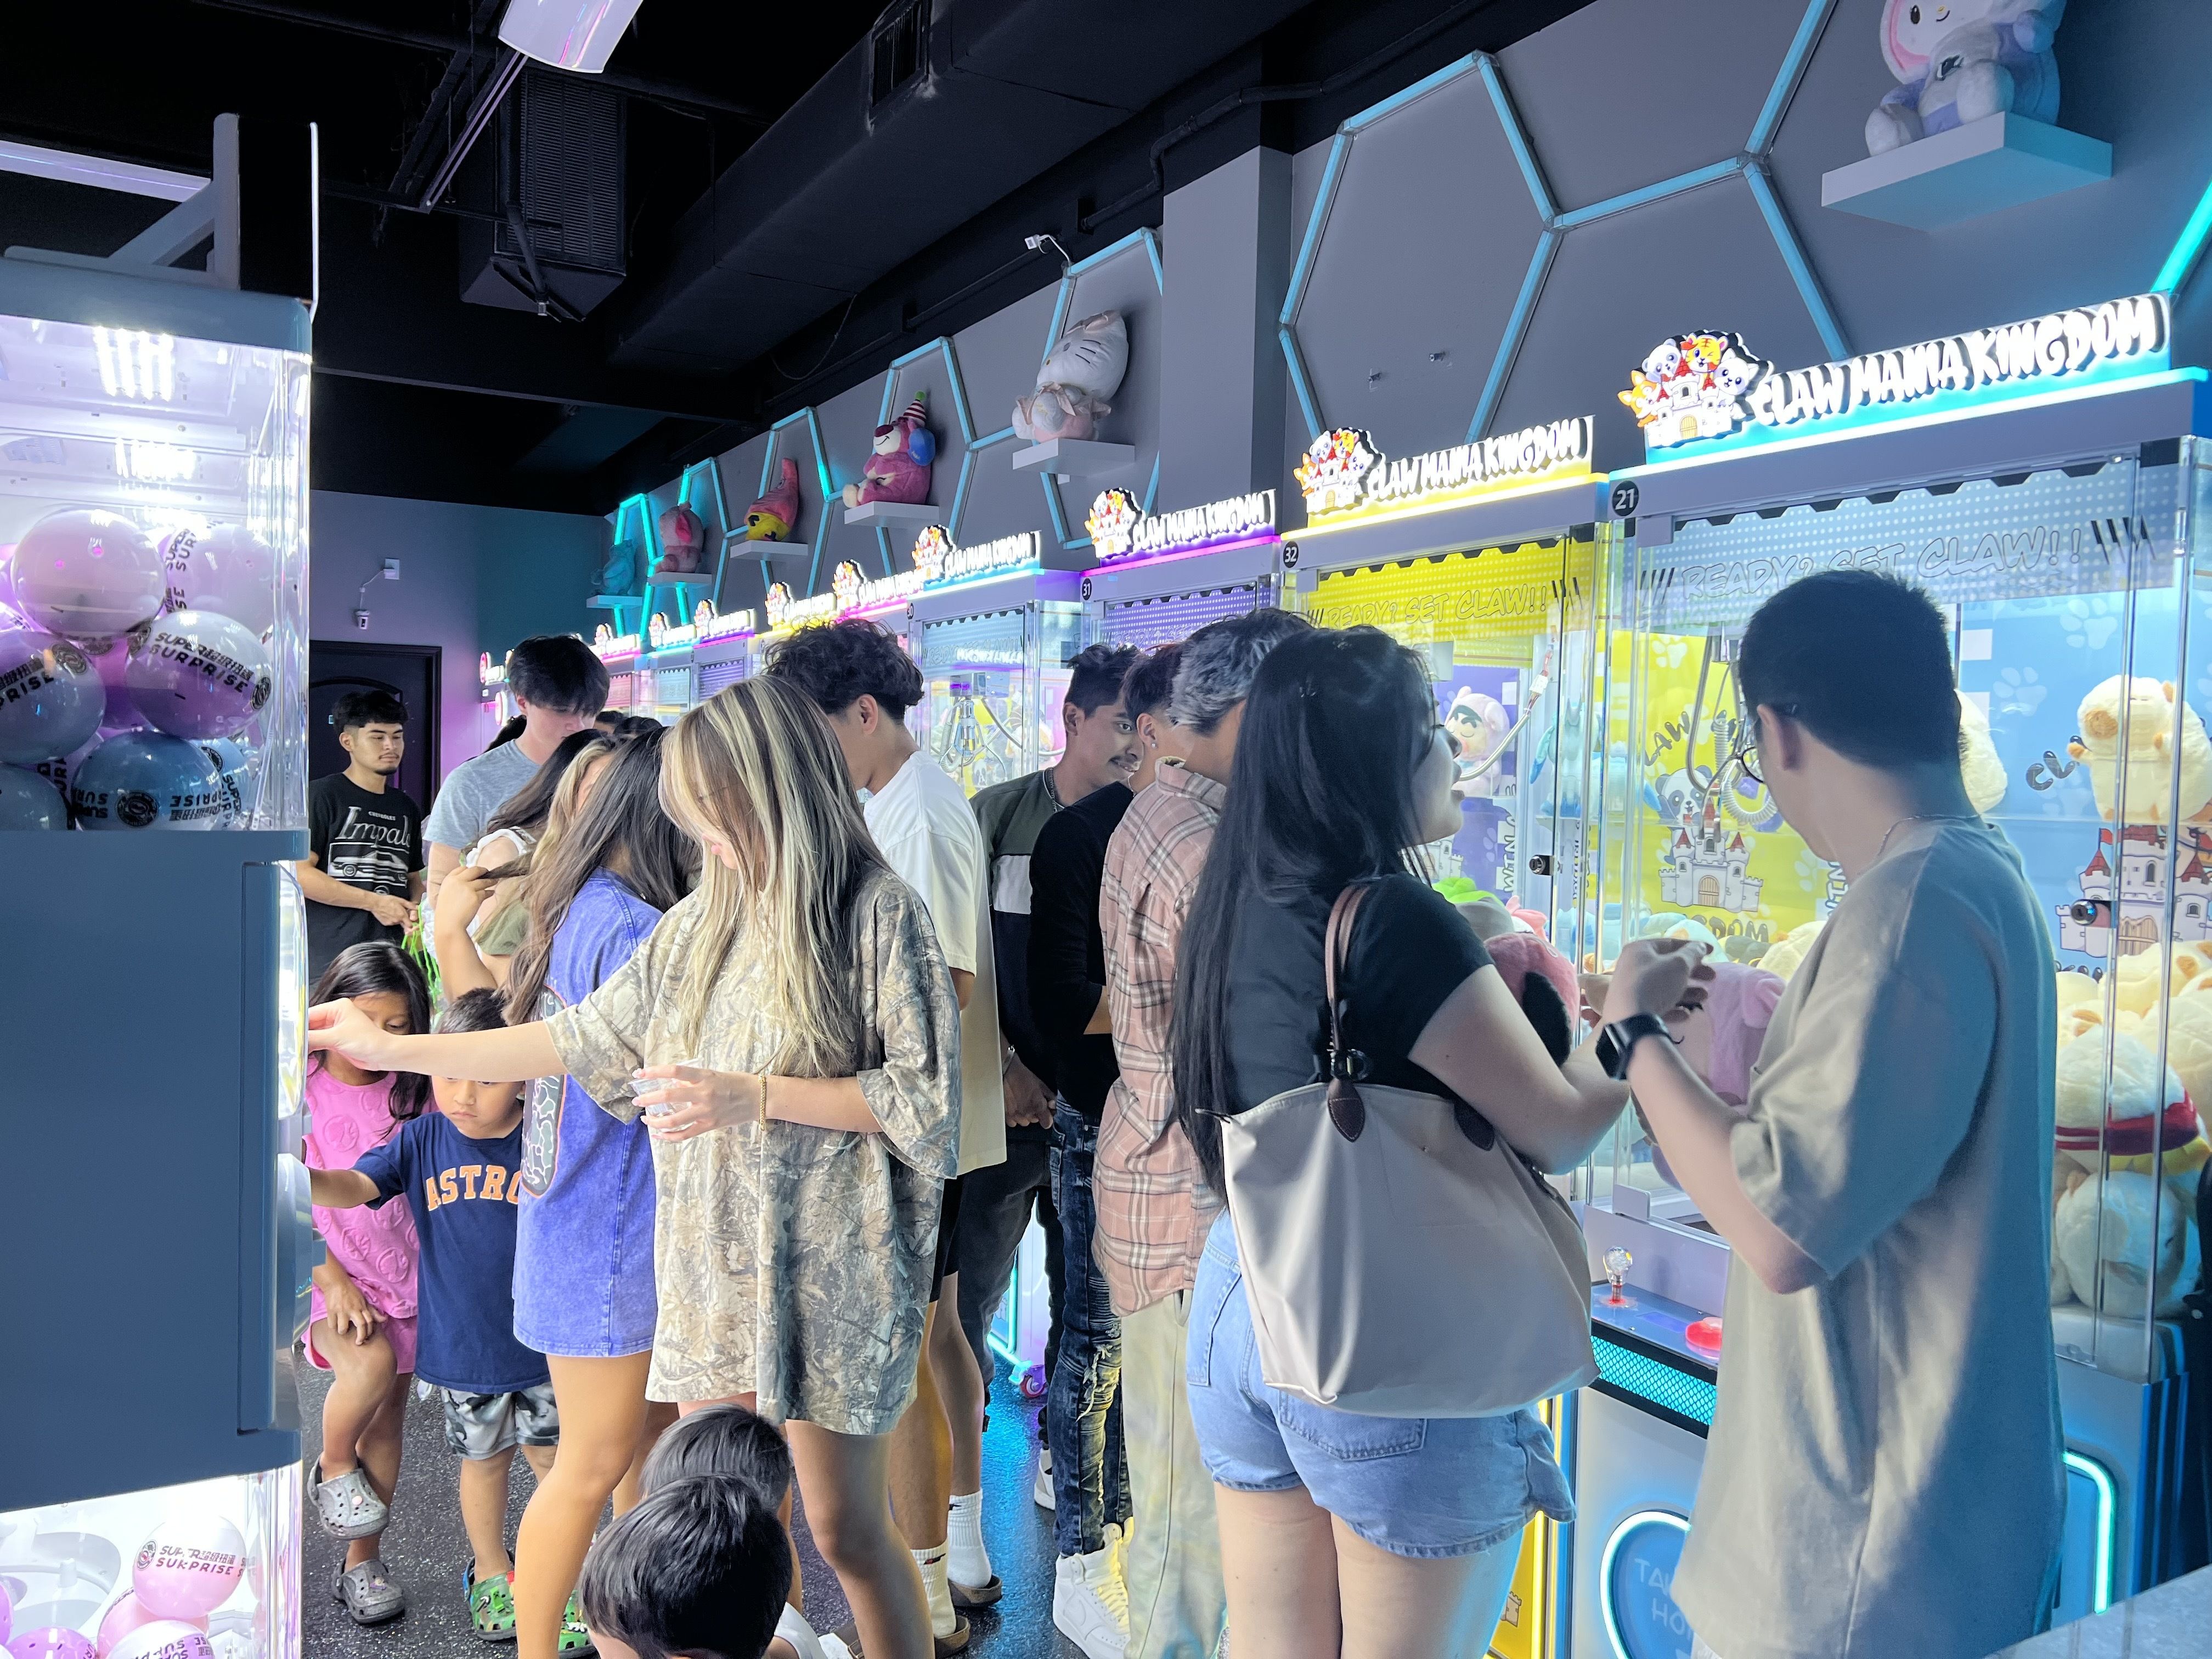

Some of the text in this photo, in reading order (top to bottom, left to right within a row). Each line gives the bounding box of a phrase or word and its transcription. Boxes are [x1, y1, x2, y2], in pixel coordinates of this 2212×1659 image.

[1757, 295, 2164, 426] CLAW MANIA KINGDOM
[1367, 418, 1585, 501] CLAW MANIA KINGDOM
[1133, 516, 1166, 549] CLAW
[1207, 492, 1266, 534] KINGDOM
[1615, 489, 1635, 510] 21
[1284, 548, 1298, 563] 32
[1682, 556, 1814, 599] READY?
[1917, 526, 2081, 578] CLAW!!
[1082, 583, 1091, 596] 31
[1328, 584, 1547, 629] READY? SET CLAW!!
[149, 644, 249, 693] SURPRISE
[1645, 711, 1690, 766] LAW
[156, 1557, 234, 1576] SURPRISE
[1651, 1598, 1692, 1640] HO
